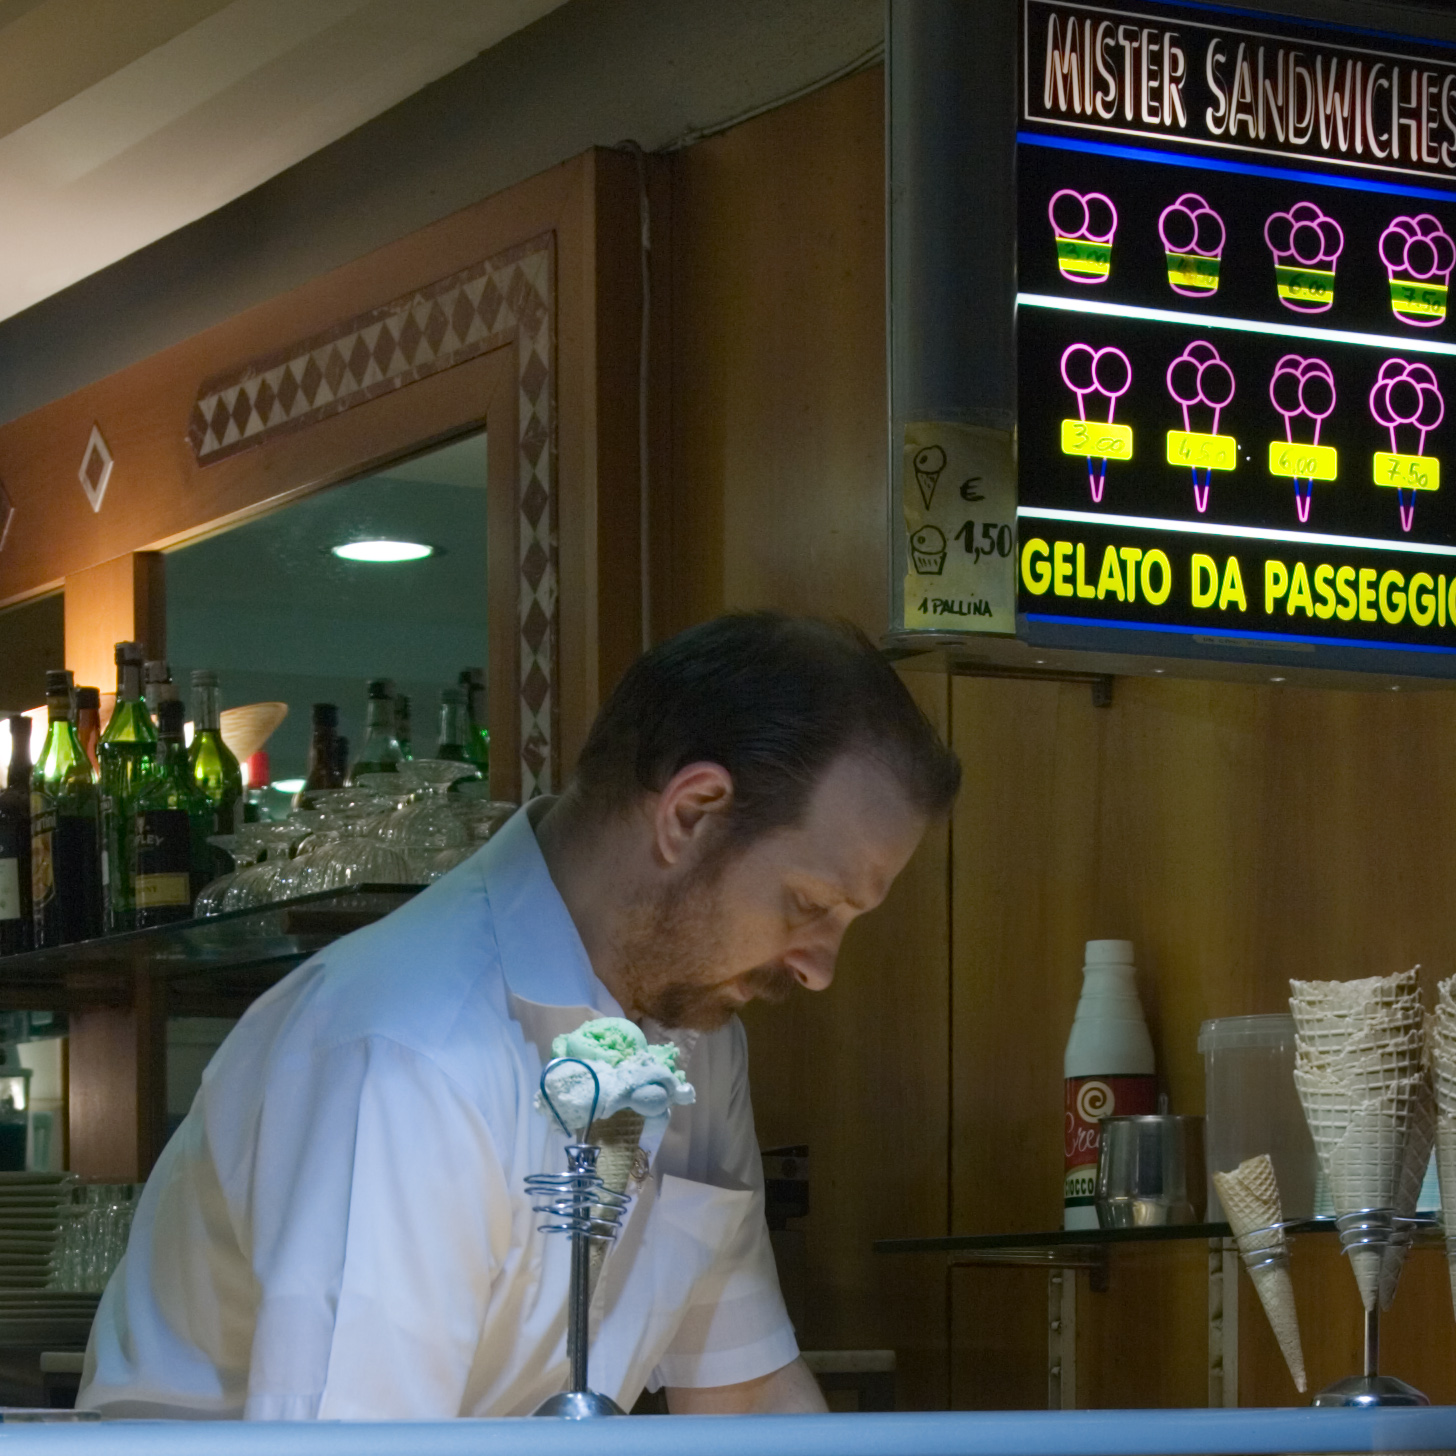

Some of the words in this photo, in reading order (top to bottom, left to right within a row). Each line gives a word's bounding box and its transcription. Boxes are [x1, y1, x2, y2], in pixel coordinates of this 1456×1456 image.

[1044, 13, 1186, 128] MISTER
[959, 476, 985, 501] €
[1387, 458, 1429, 487] 7.50
[1021, 537, 1171, 605] GELATO
[1191, 553, 1247, 612] DA
